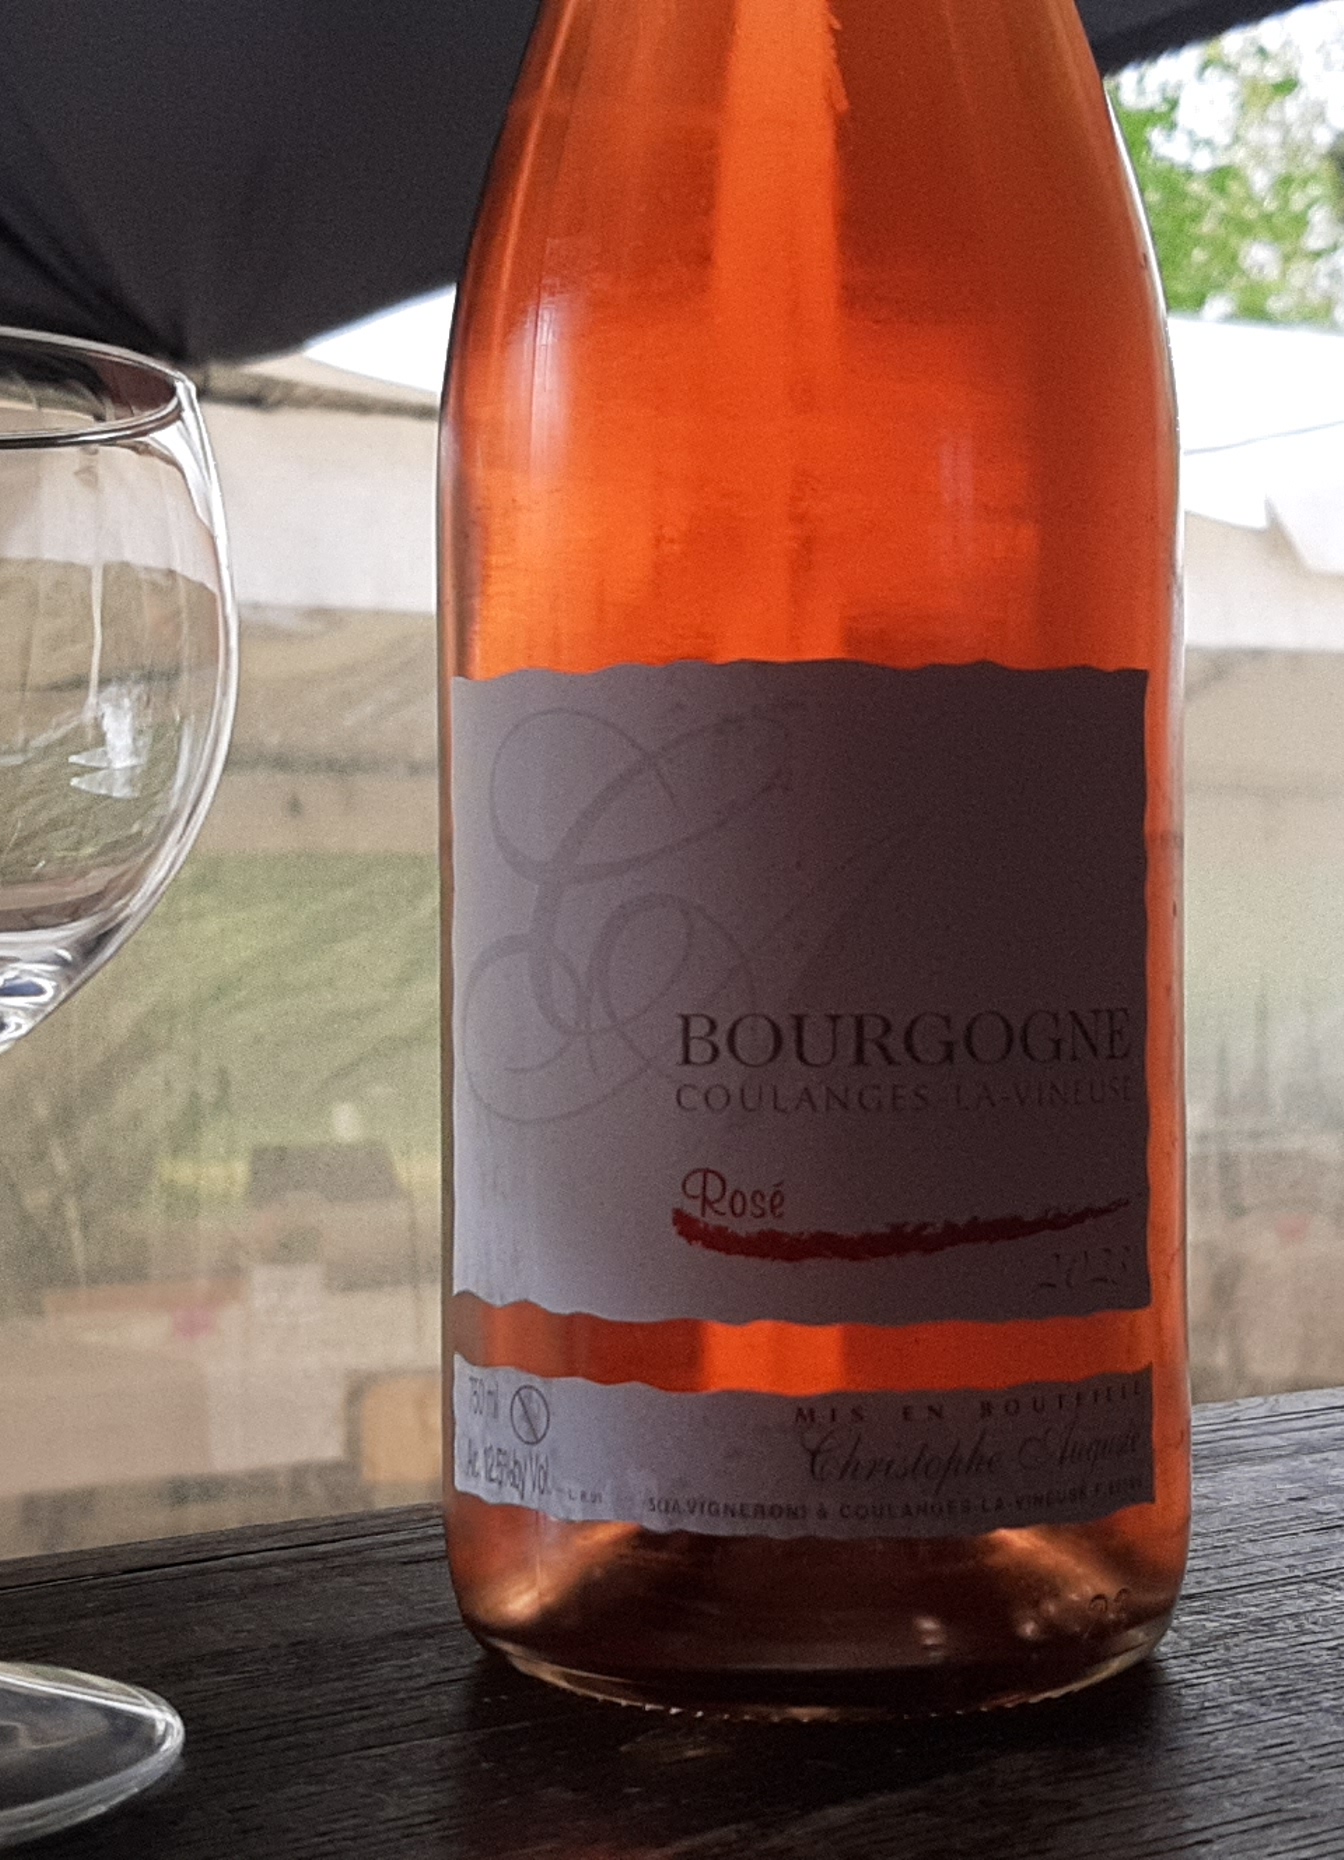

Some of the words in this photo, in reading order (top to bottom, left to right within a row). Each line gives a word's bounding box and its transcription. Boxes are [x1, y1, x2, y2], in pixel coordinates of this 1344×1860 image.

[675, 1007, 1132, 1068] BOURGOGNE
[681, 1166, 786, 1220] Rosé
[795, 1404, 867, 1425] MIS
[902, 1403, 946, 1422] EN
